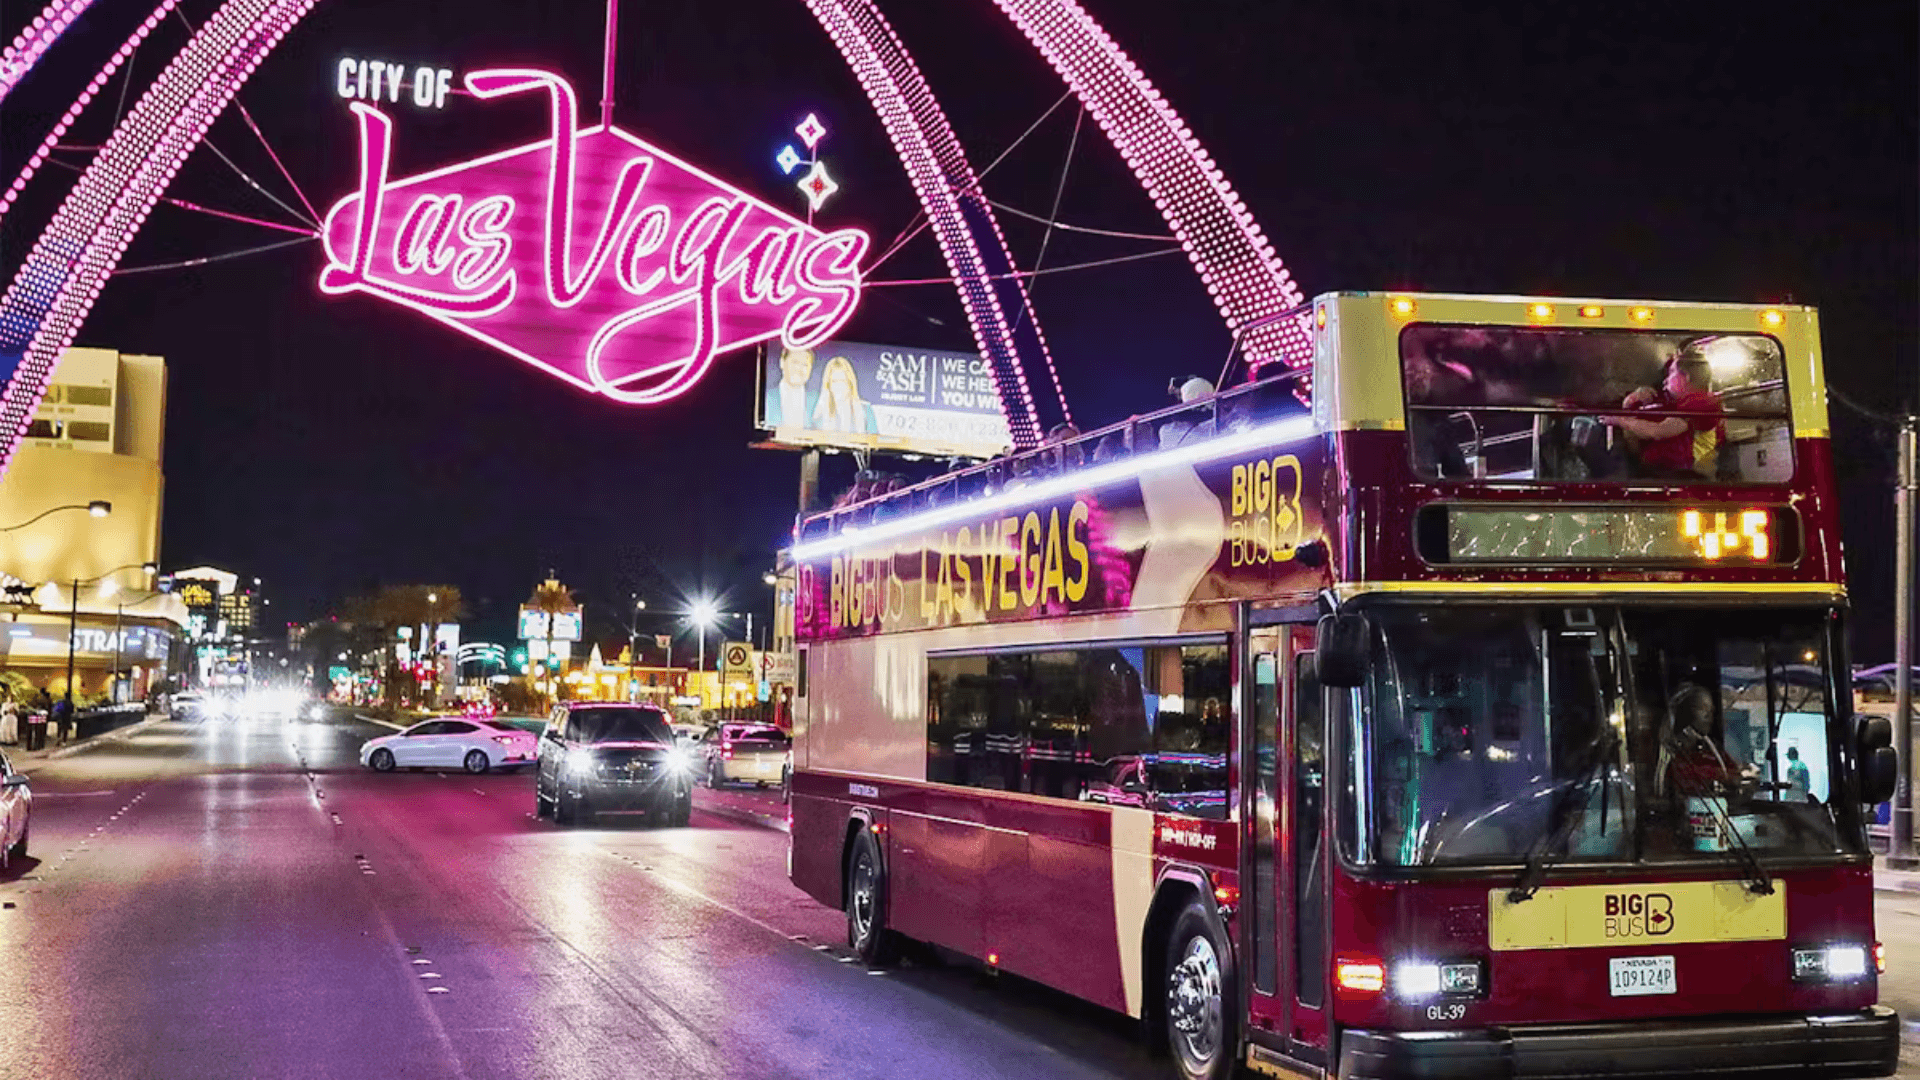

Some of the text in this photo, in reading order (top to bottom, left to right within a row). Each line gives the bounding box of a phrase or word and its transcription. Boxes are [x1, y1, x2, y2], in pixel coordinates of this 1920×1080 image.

[338, 57, 453, 109] CITY OF
[319, 67, 870, 404] Las Vegas
[880, 352, 927, 374] SAM
[941, 357, 989, 375] WE CA
[882, 371, 926, 393] ASH
[941, 374, 995, 393] WE HEL
[941, 391, 1000, 410] YOU WI
[1231, 459, 1271, 517] BIG
[1231, 516, 1270, 568] BUS
[920, 525, 973, 618] LAS
[980, 500, 1089, 612] VEGAS
[68, 628, 128, 652] STRAT
[1605, 893, 1643, 916] BIG
[1604, 917, 1644, 938] BUS
[1614, 967, 1672, 989] 109124P
[1426, 1004, 1467, 1021] GL-39
